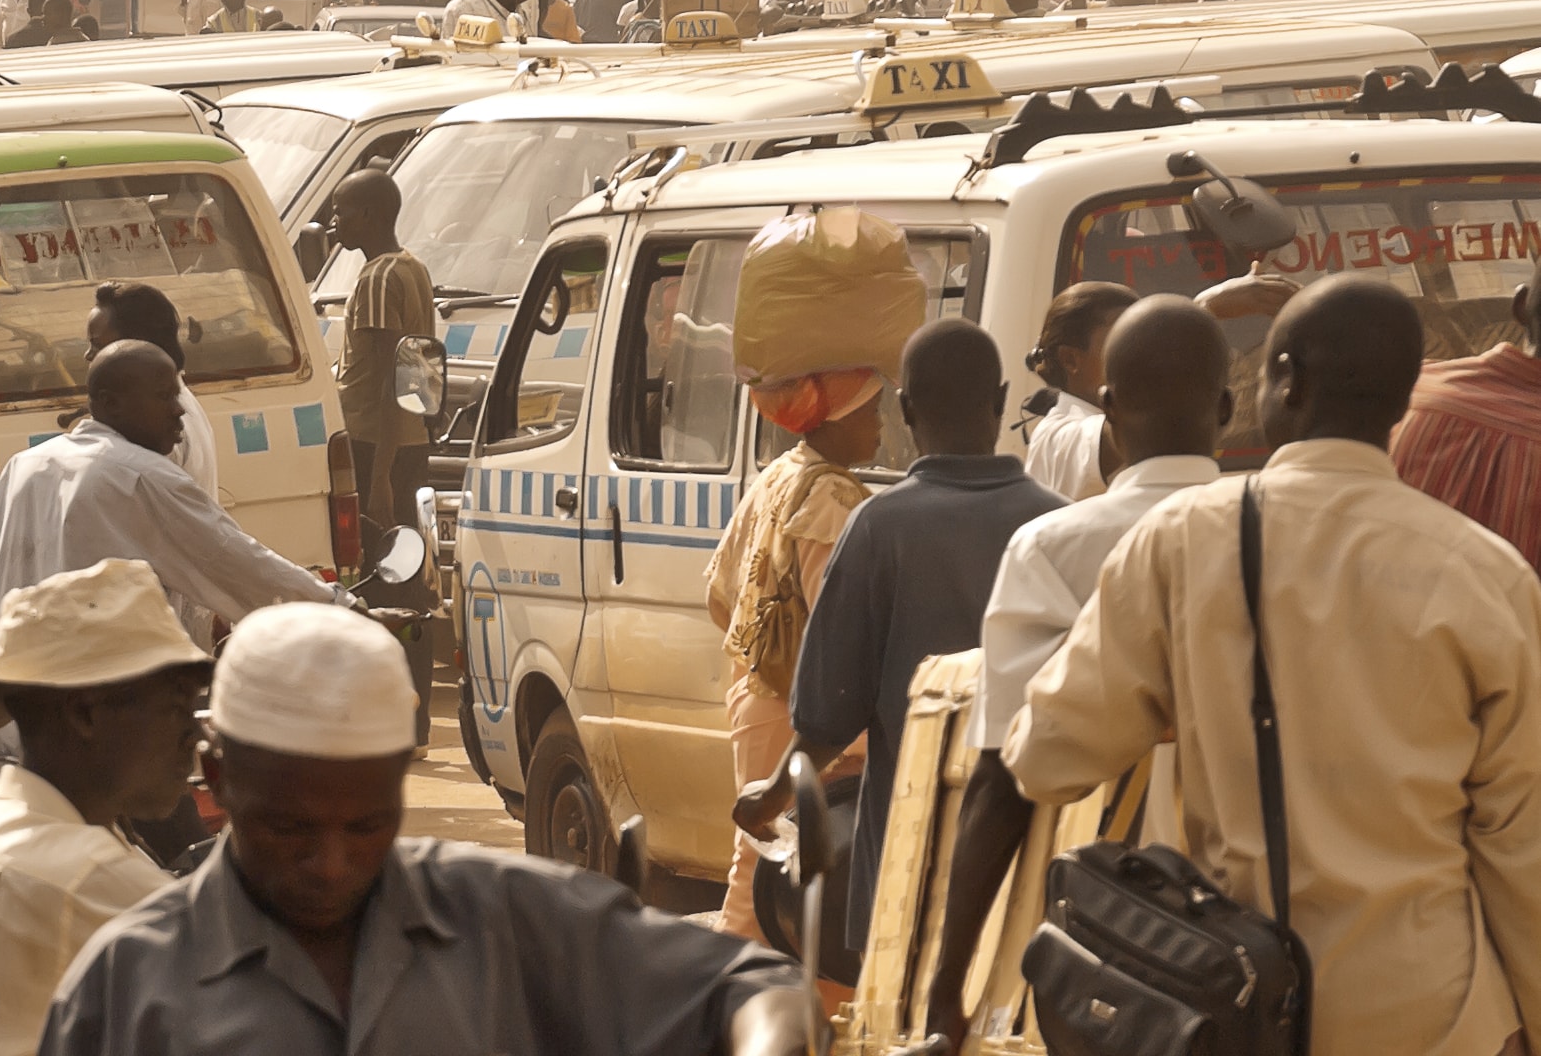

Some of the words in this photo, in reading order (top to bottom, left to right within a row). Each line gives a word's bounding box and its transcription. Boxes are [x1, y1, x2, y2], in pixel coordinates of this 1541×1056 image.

[458, 20, 486, 41] TAXI
[676, 17, 718, 40] TAXI
[882, 58, 971, 95] TAXI
